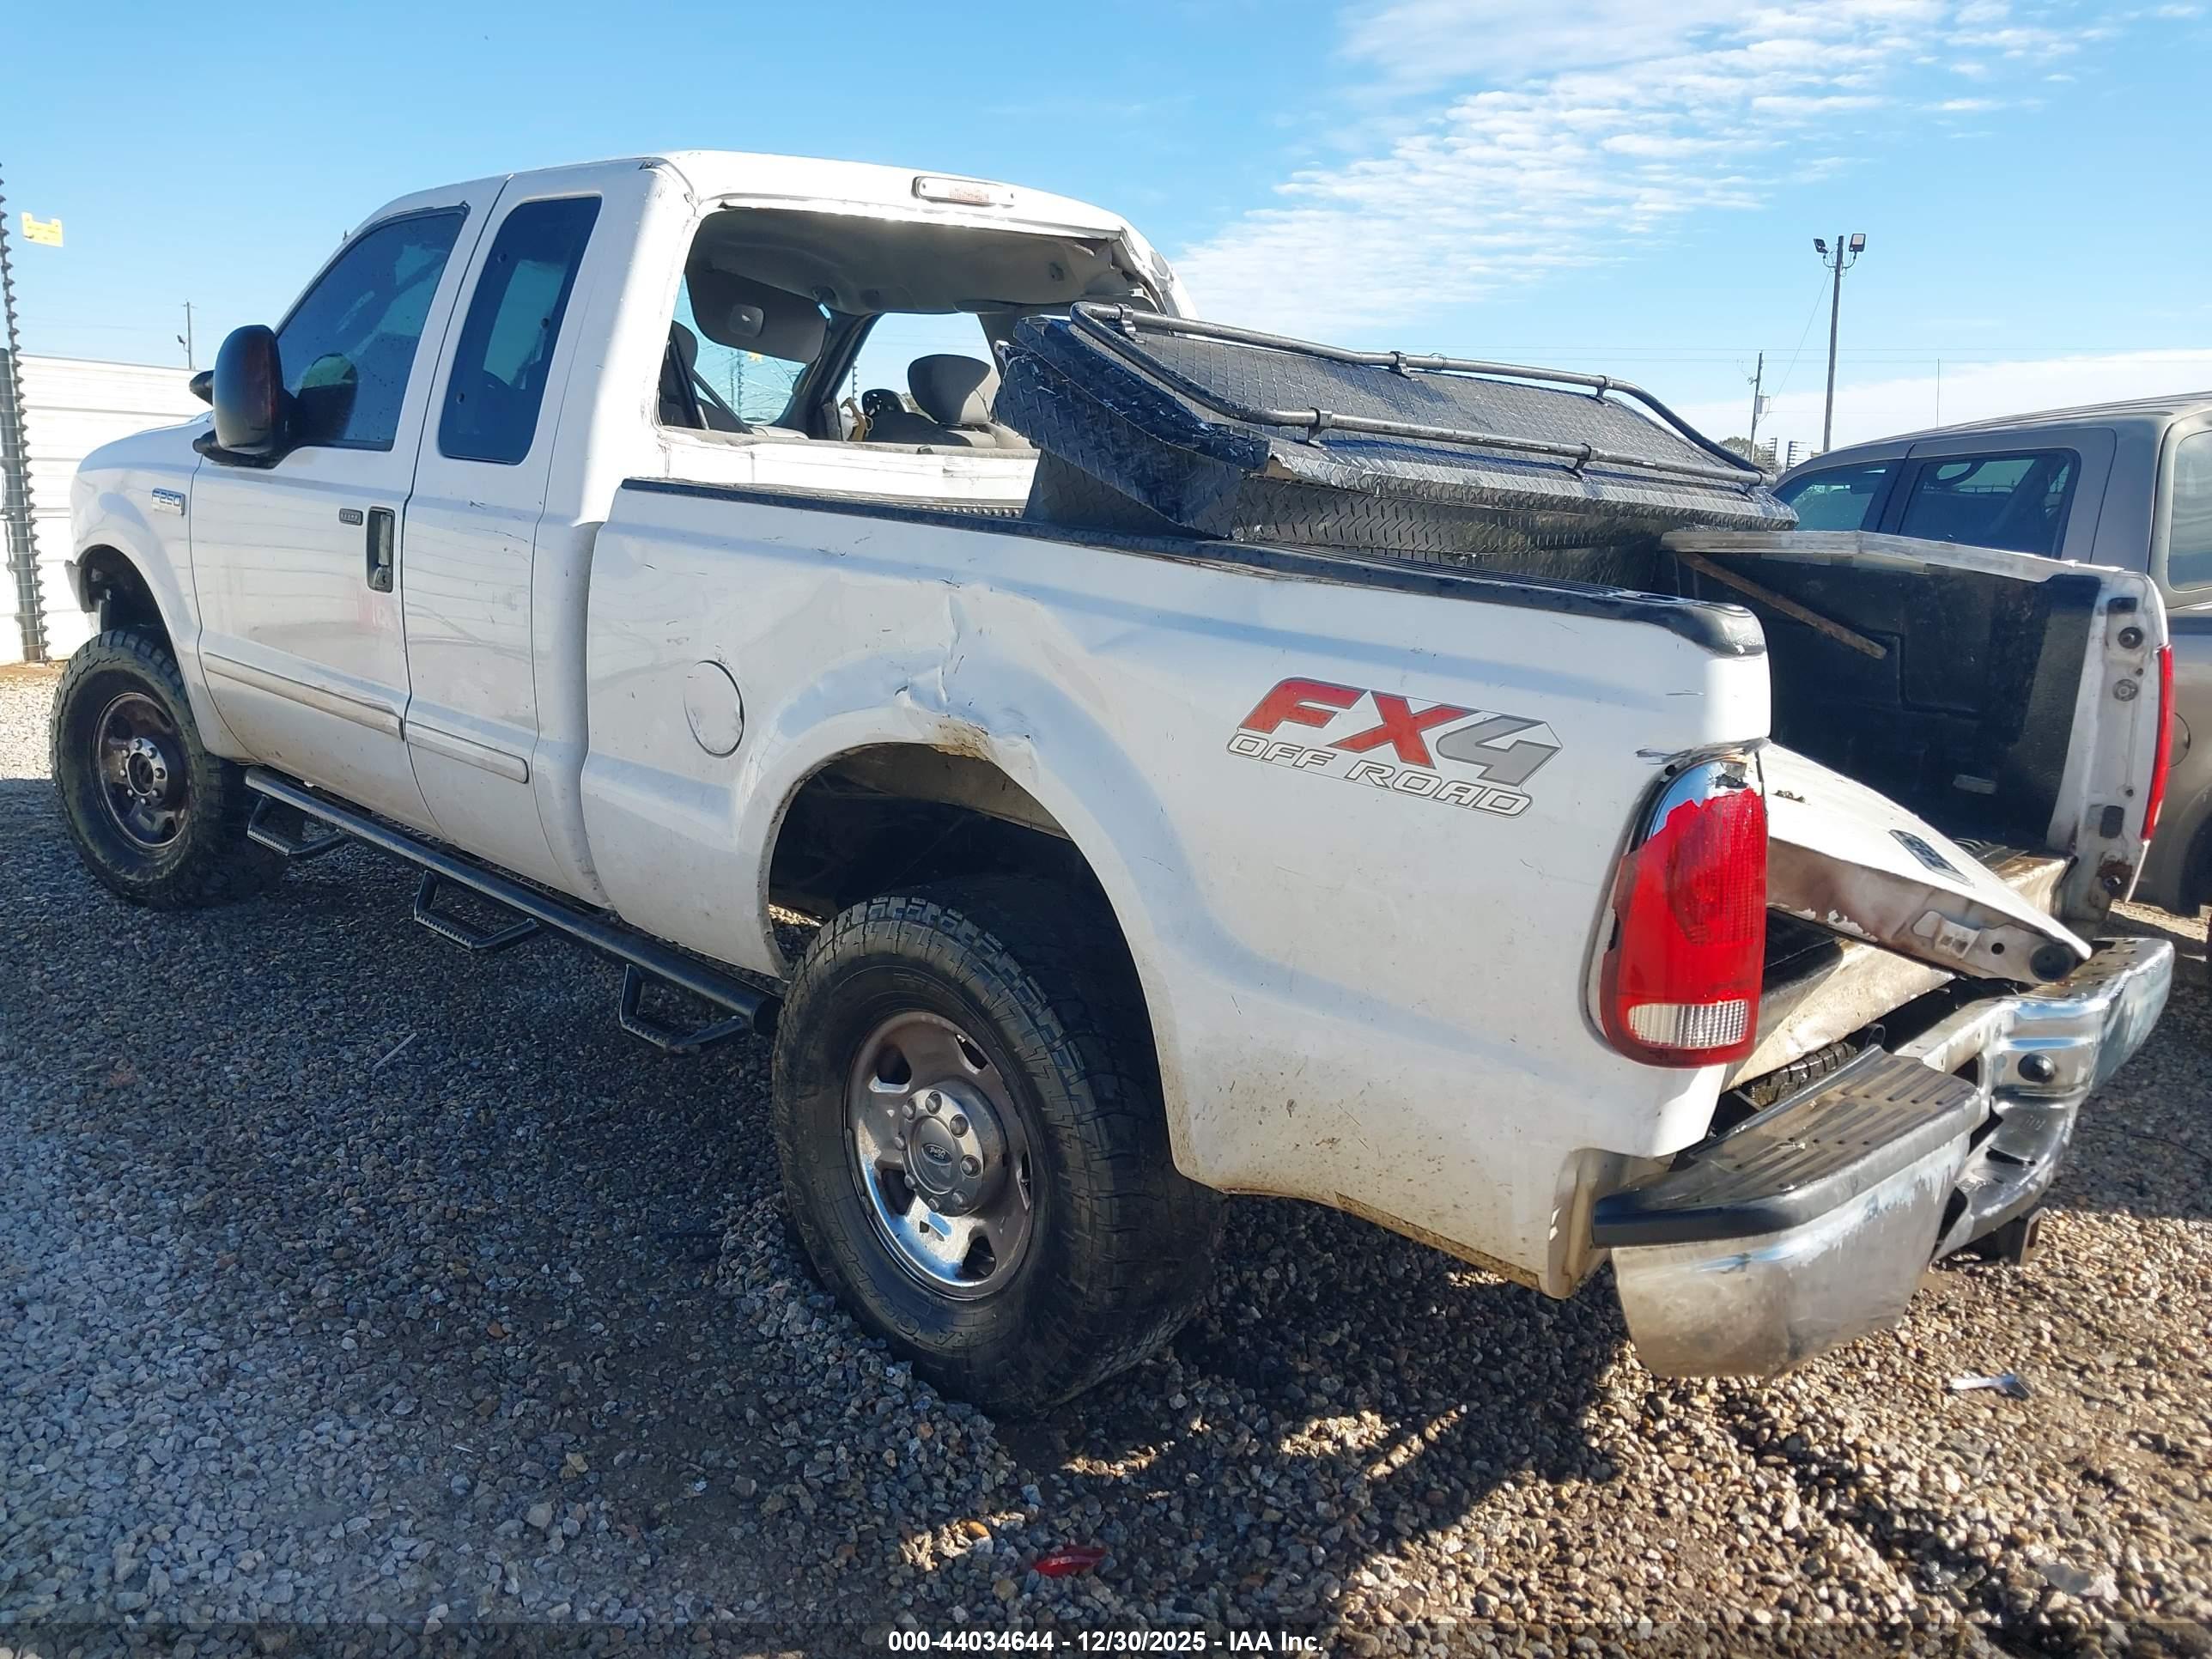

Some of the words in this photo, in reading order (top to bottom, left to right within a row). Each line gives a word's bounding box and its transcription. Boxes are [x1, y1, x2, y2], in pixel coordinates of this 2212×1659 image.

[1238, 677, 1560, 787] FX4
[1227, 733, 1336, 769] OFF
[1345, 760, 1533, 817] ROAD
[929, 1146, 946, 1160] Ford
